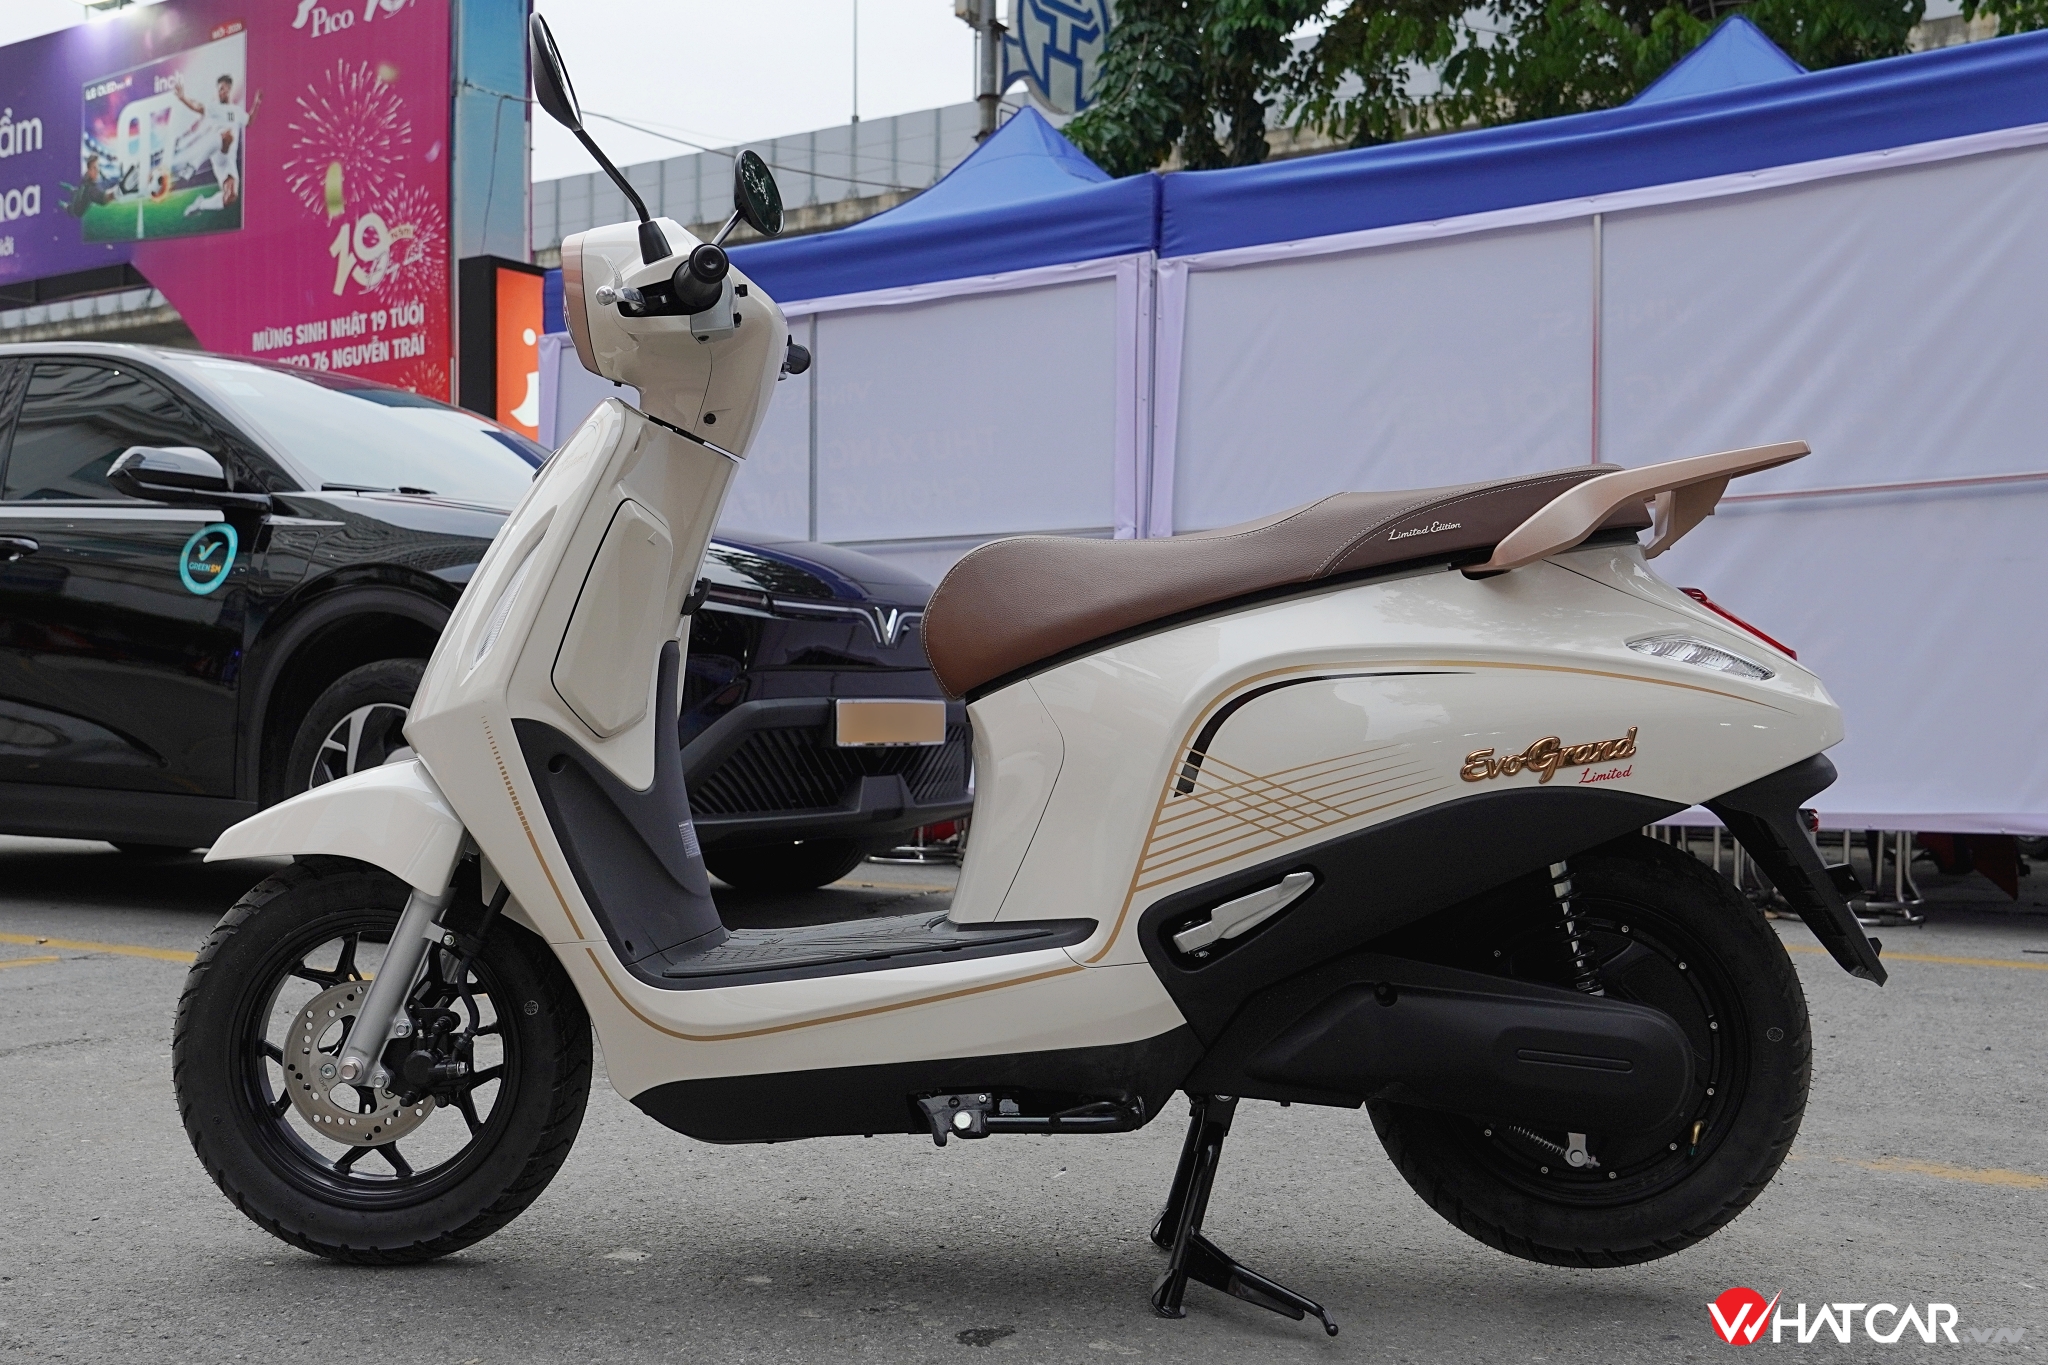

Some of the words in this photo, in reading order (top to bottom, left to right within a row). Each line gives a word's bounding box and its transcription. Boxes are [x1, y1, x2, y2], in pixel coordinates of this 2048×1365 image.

[296, 320, 328, 345] SINH
[330, 310, 368, 338] NHẬT
[370, 309, 387, 332] 19
[311, 350, 330, 371] 76
[332, 335, 389, 370] NGUYỄN
[1388, 528, 1430, 541] Limited
[1430, 521, 1462, 533] Edition
[1578, 765, 1632, 784] Limited
